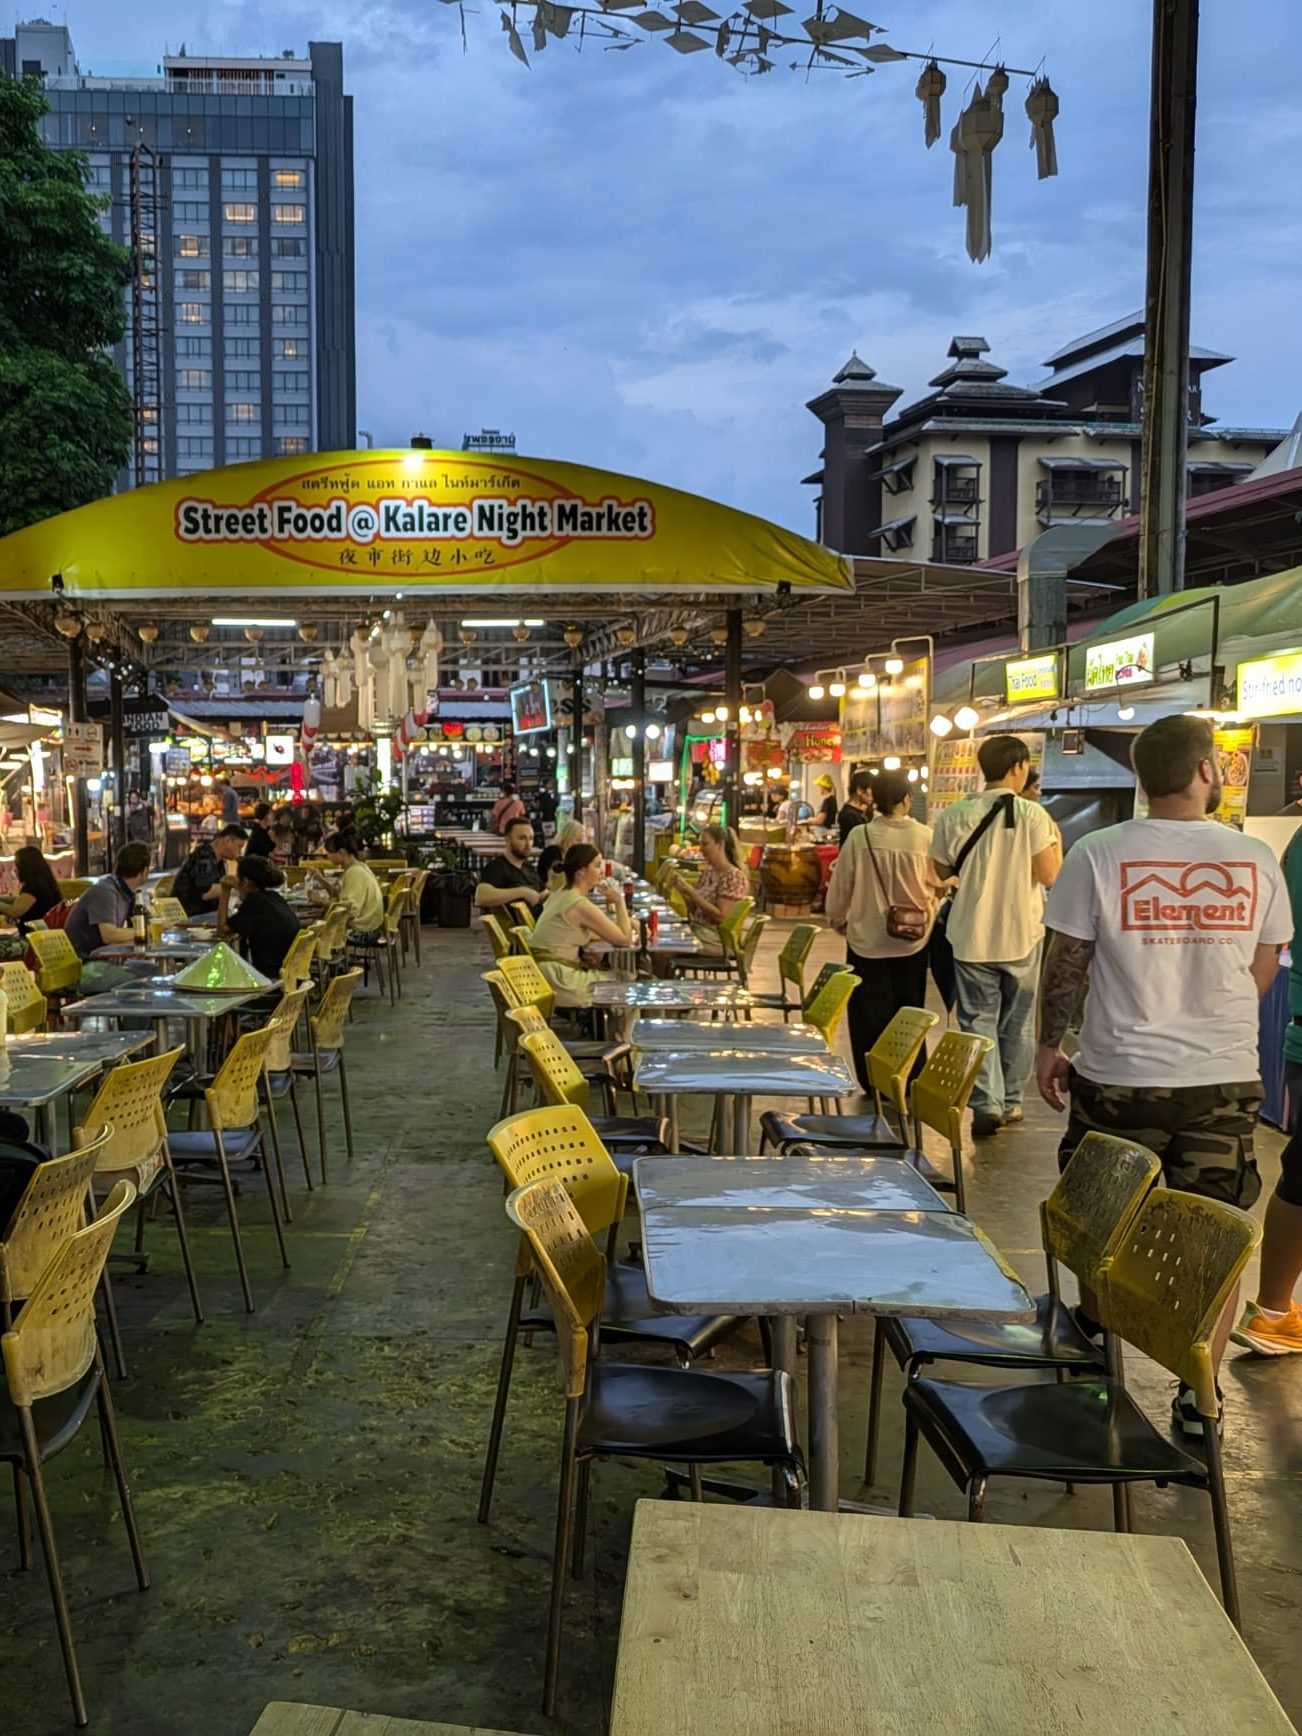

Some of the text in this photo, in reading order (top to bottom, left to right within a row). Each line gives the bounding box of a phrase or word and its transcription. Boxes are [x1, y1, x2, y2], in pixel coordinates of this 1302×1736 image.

[367, 479, 395, 489] แอท
[183, 503, 648, 540] Street Food @ Kalare Night Market
[338, 547, 496, 567] 夜市街边小吃
[1022, 672, 1037, 688] Food
[1243, 673, 1285, 700] Stir-fried
[1133, 896, 1246, 921] Element
